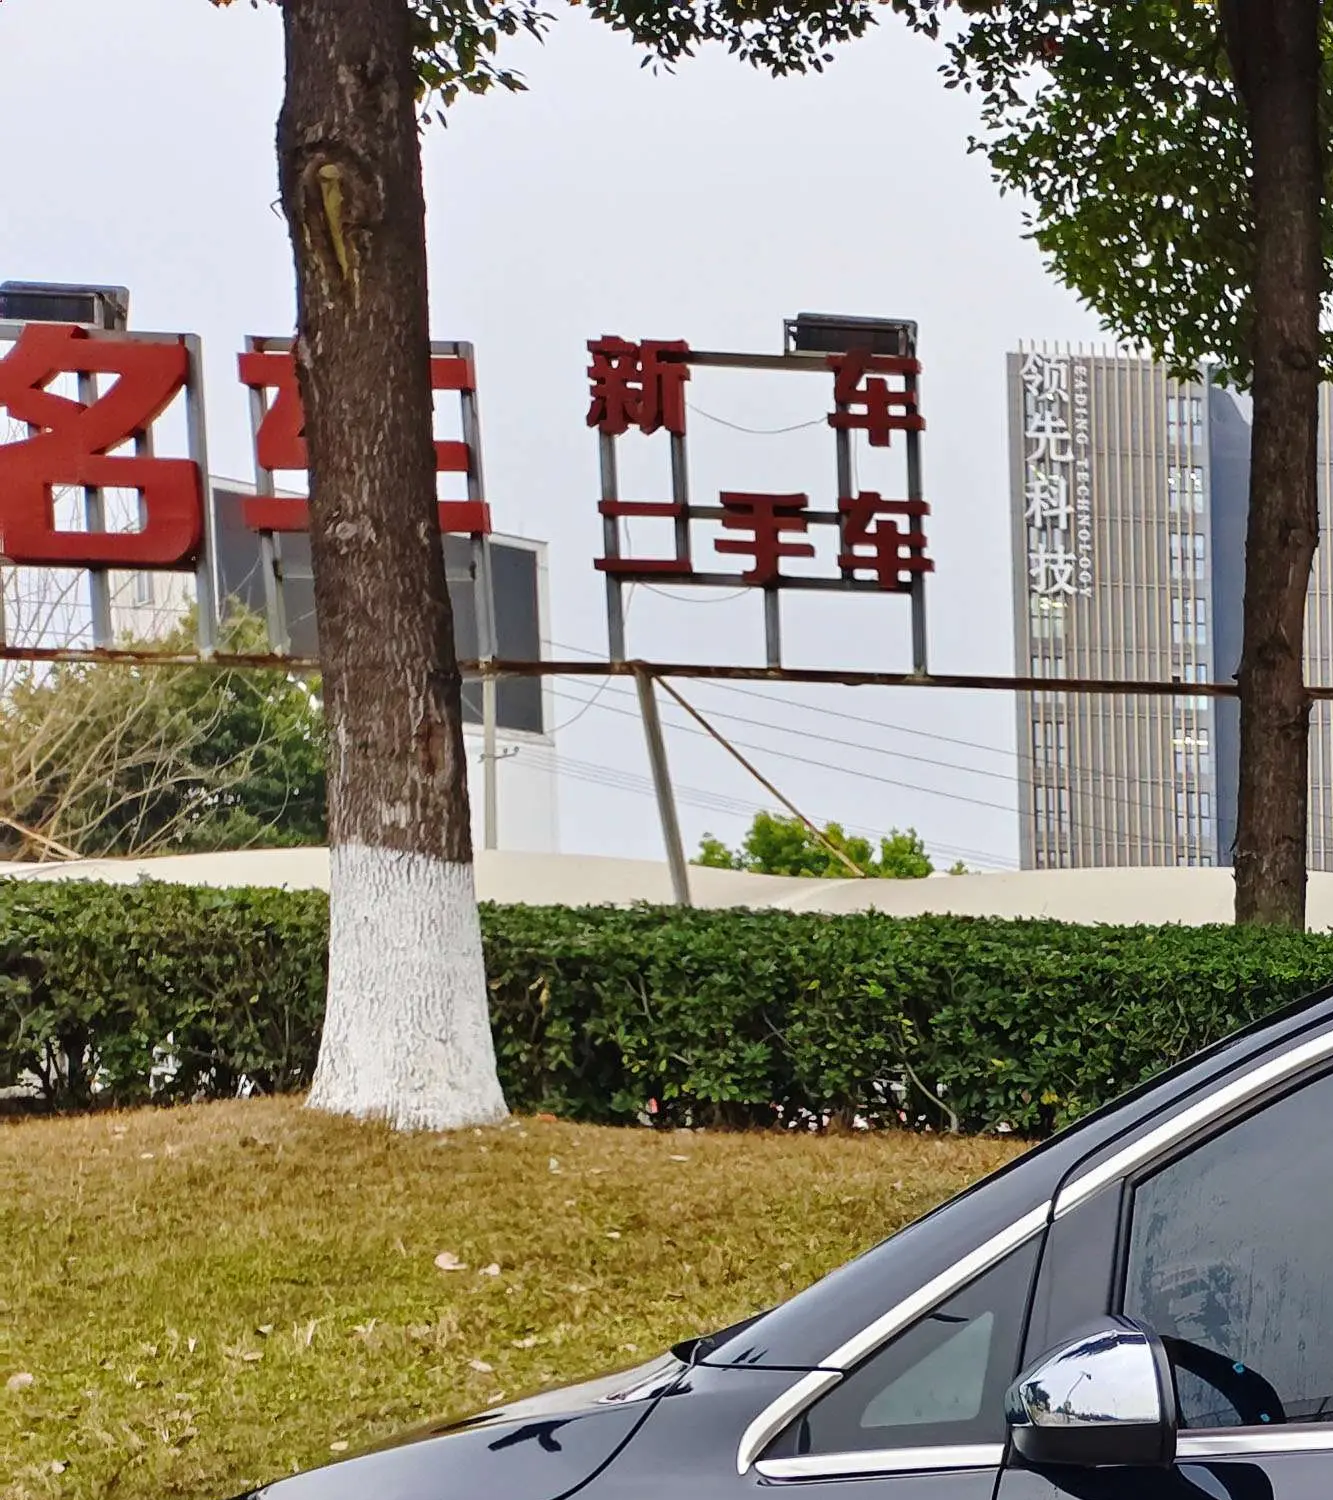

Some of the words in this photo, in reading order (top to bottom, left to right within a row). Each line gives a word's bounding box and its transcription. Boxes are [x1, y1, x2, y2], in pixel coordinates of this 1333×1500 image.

[586, 335, 926, 447] 新车
[1020, 352, 1078, 595] 领先科技
[593, 491, 935, 588] 二手车
